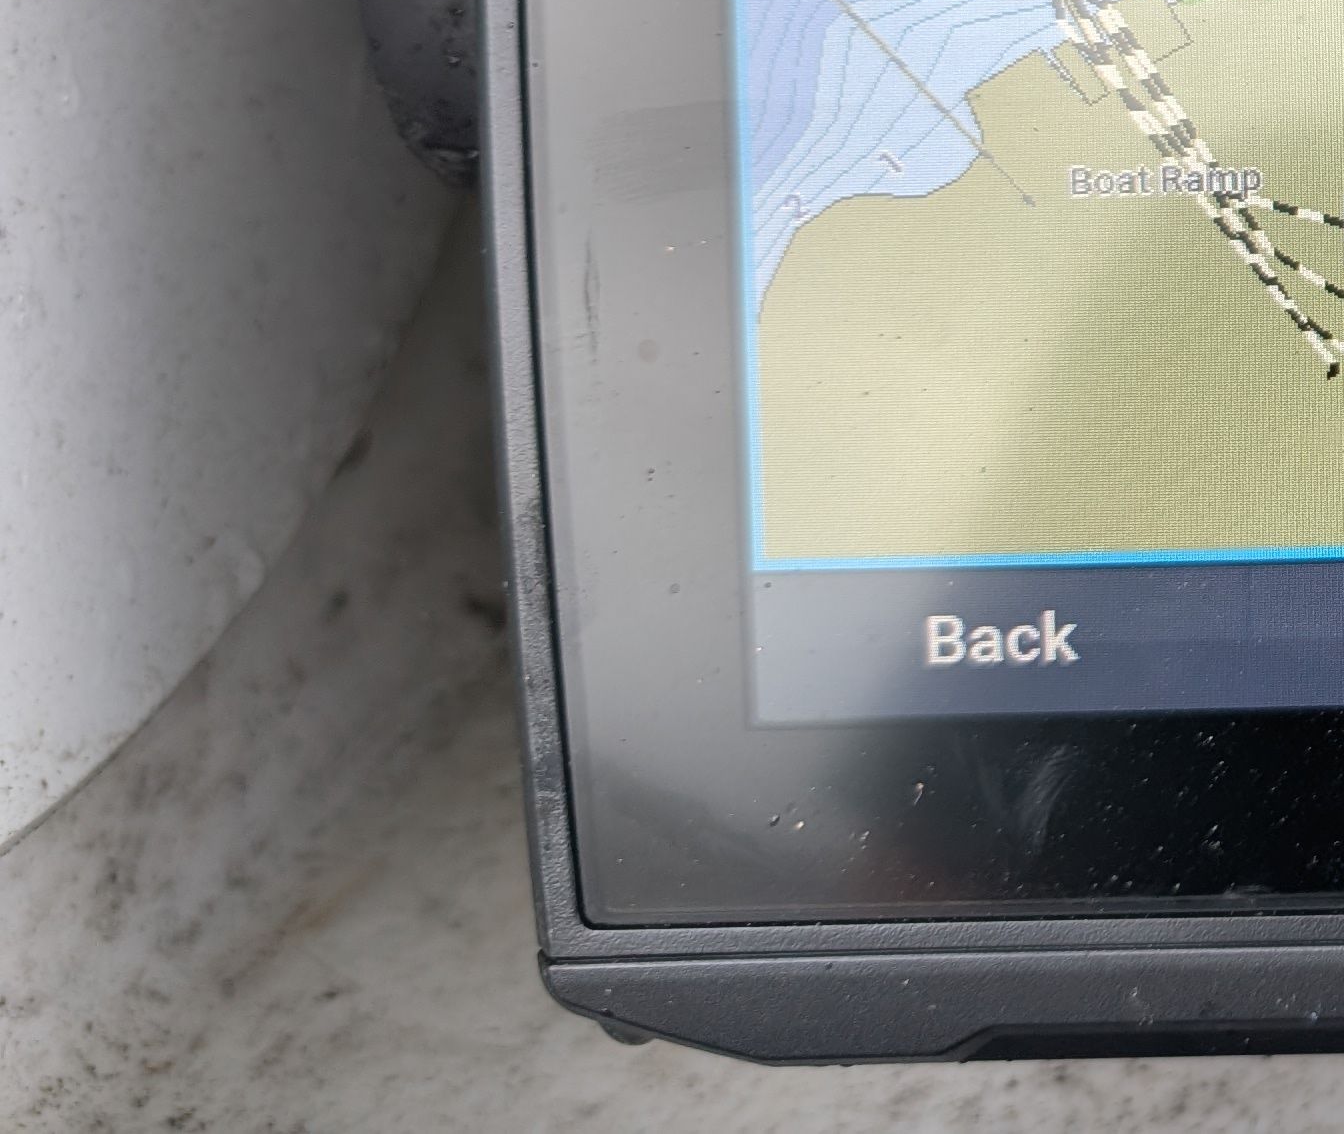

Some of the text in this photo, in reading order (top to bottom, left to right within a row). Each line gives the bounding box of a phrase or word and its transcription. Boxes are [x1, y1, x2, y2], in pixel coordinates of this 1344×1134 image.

[1070, 165, 1263, 201] Boat Ramp
[925, 609, 1080, 665] Back
